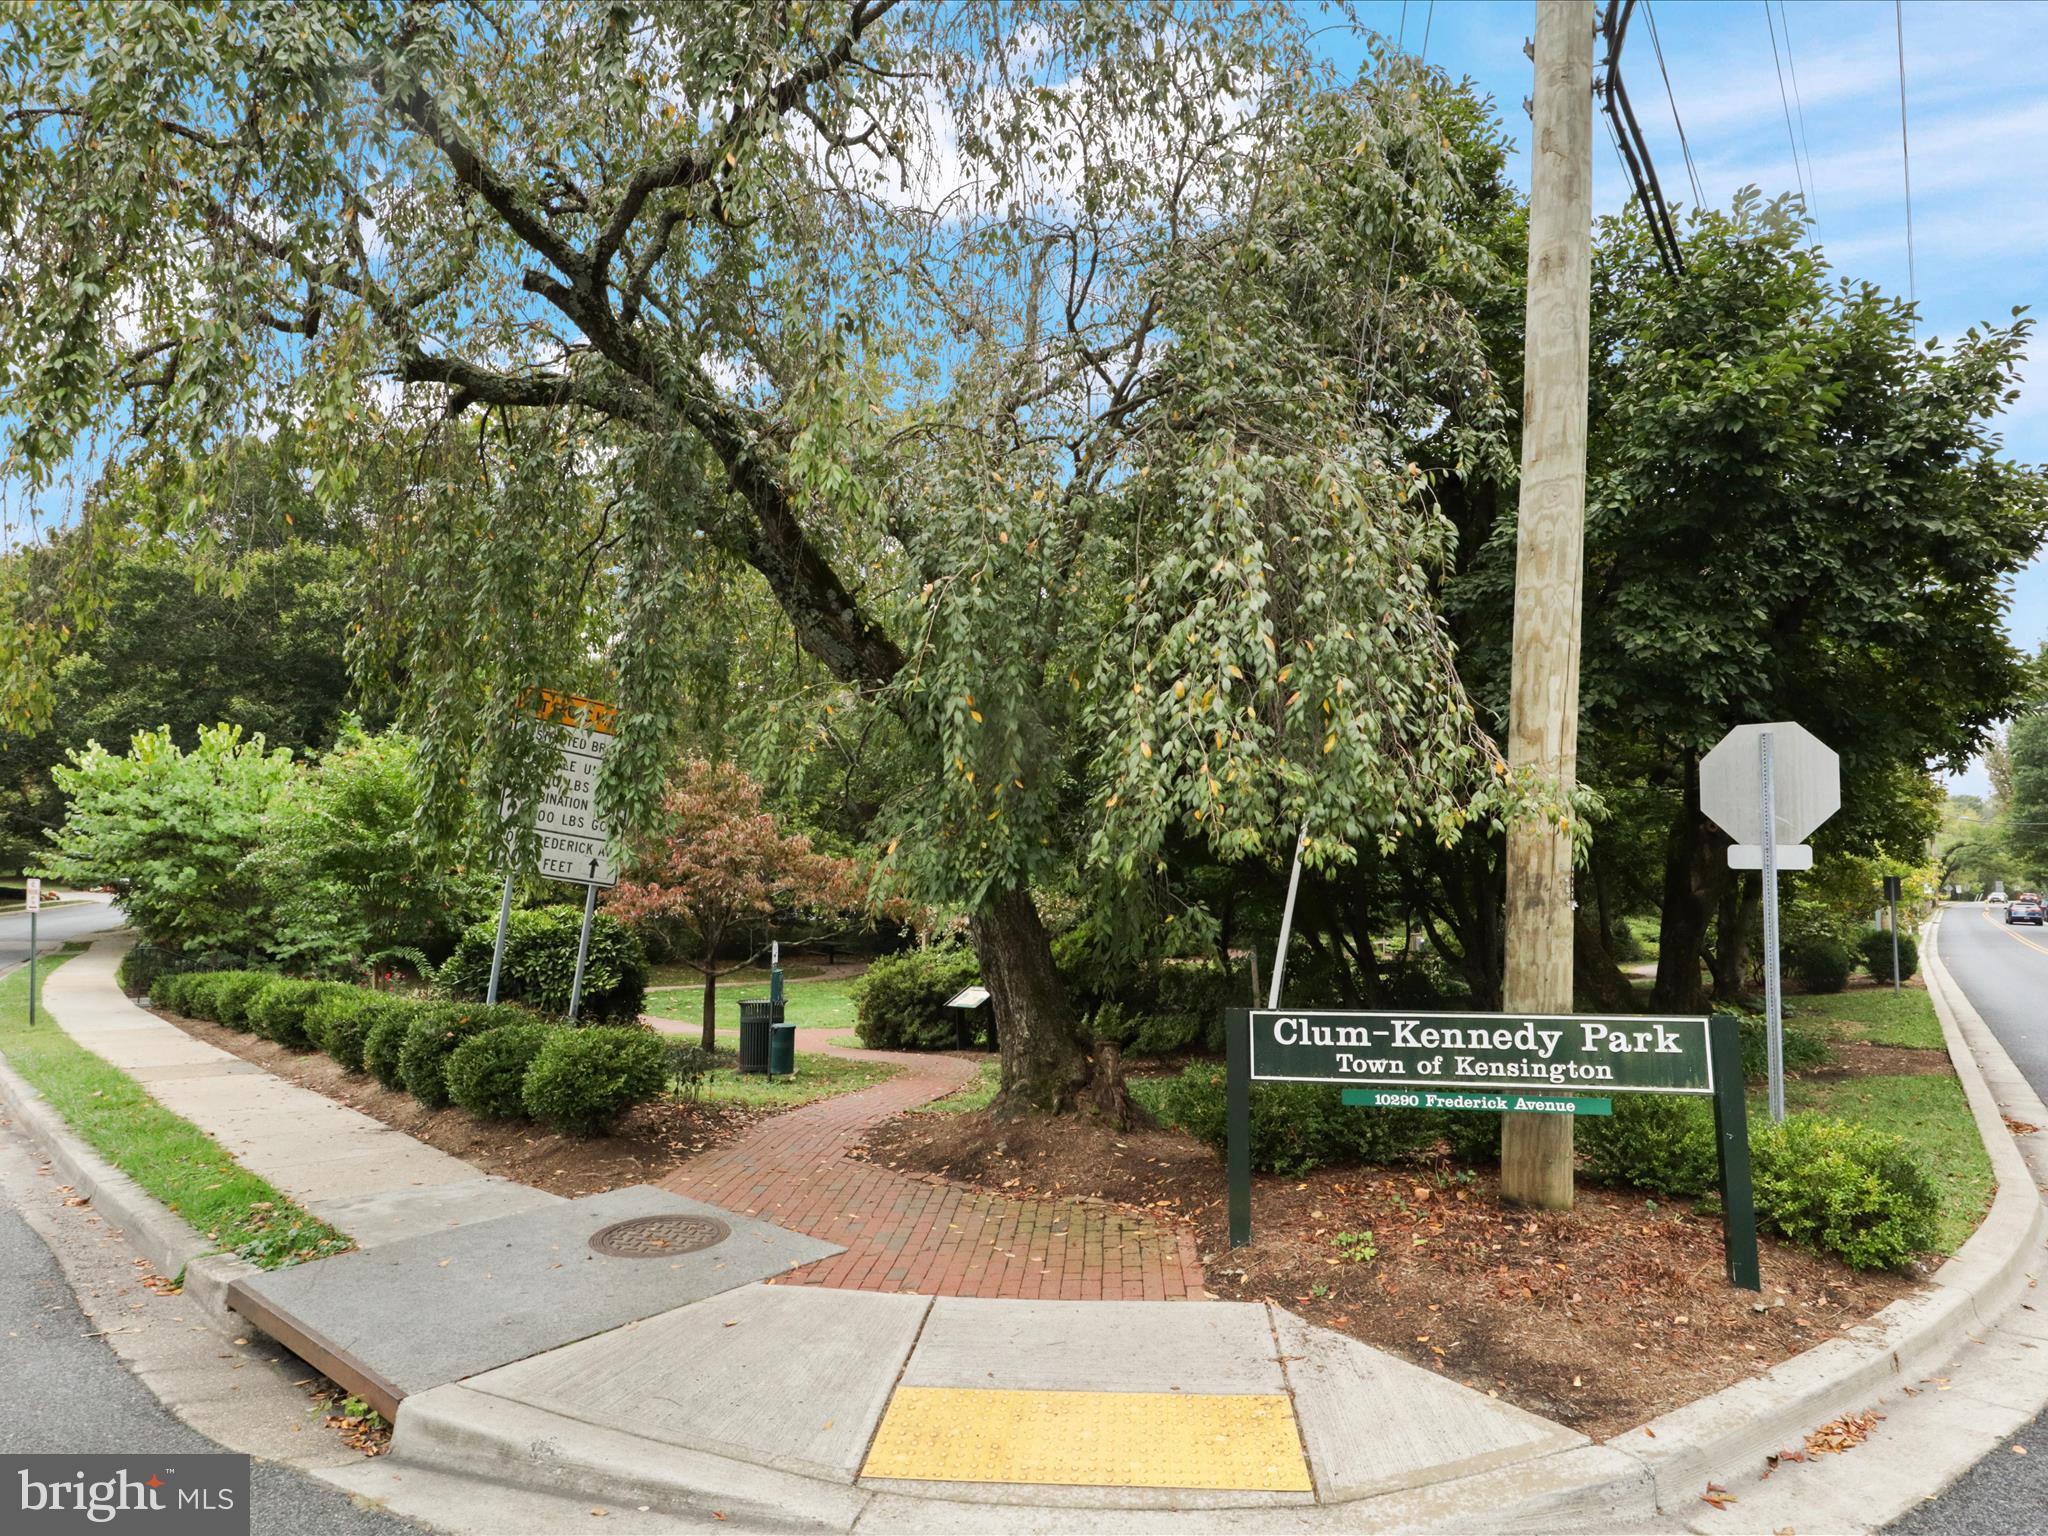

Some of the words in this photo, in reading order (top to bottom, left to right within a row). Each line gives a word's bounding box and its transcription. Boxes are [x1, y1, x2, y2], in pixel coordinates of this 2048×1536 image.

[562, 814, 584, 828] LBS
[543, 836, 593, 855] EDERICK
[543, 858, 573, 873] FEET
[1273, 1018, 1563, 1058] Clum-Kennedy
[1580, 1023, 1683, 1053] Park
[1337, 1054, 1406, 1074] Town
[1417, 1056, 1443, 1075] of
[1454, 1056, 1613, 1083] Kensington
[1375, 1094, 1419, 1107] 10290
[1425, 1095, 1508, 1110] Frederick
[1514, 1097, 1575, 1112] Avenue
